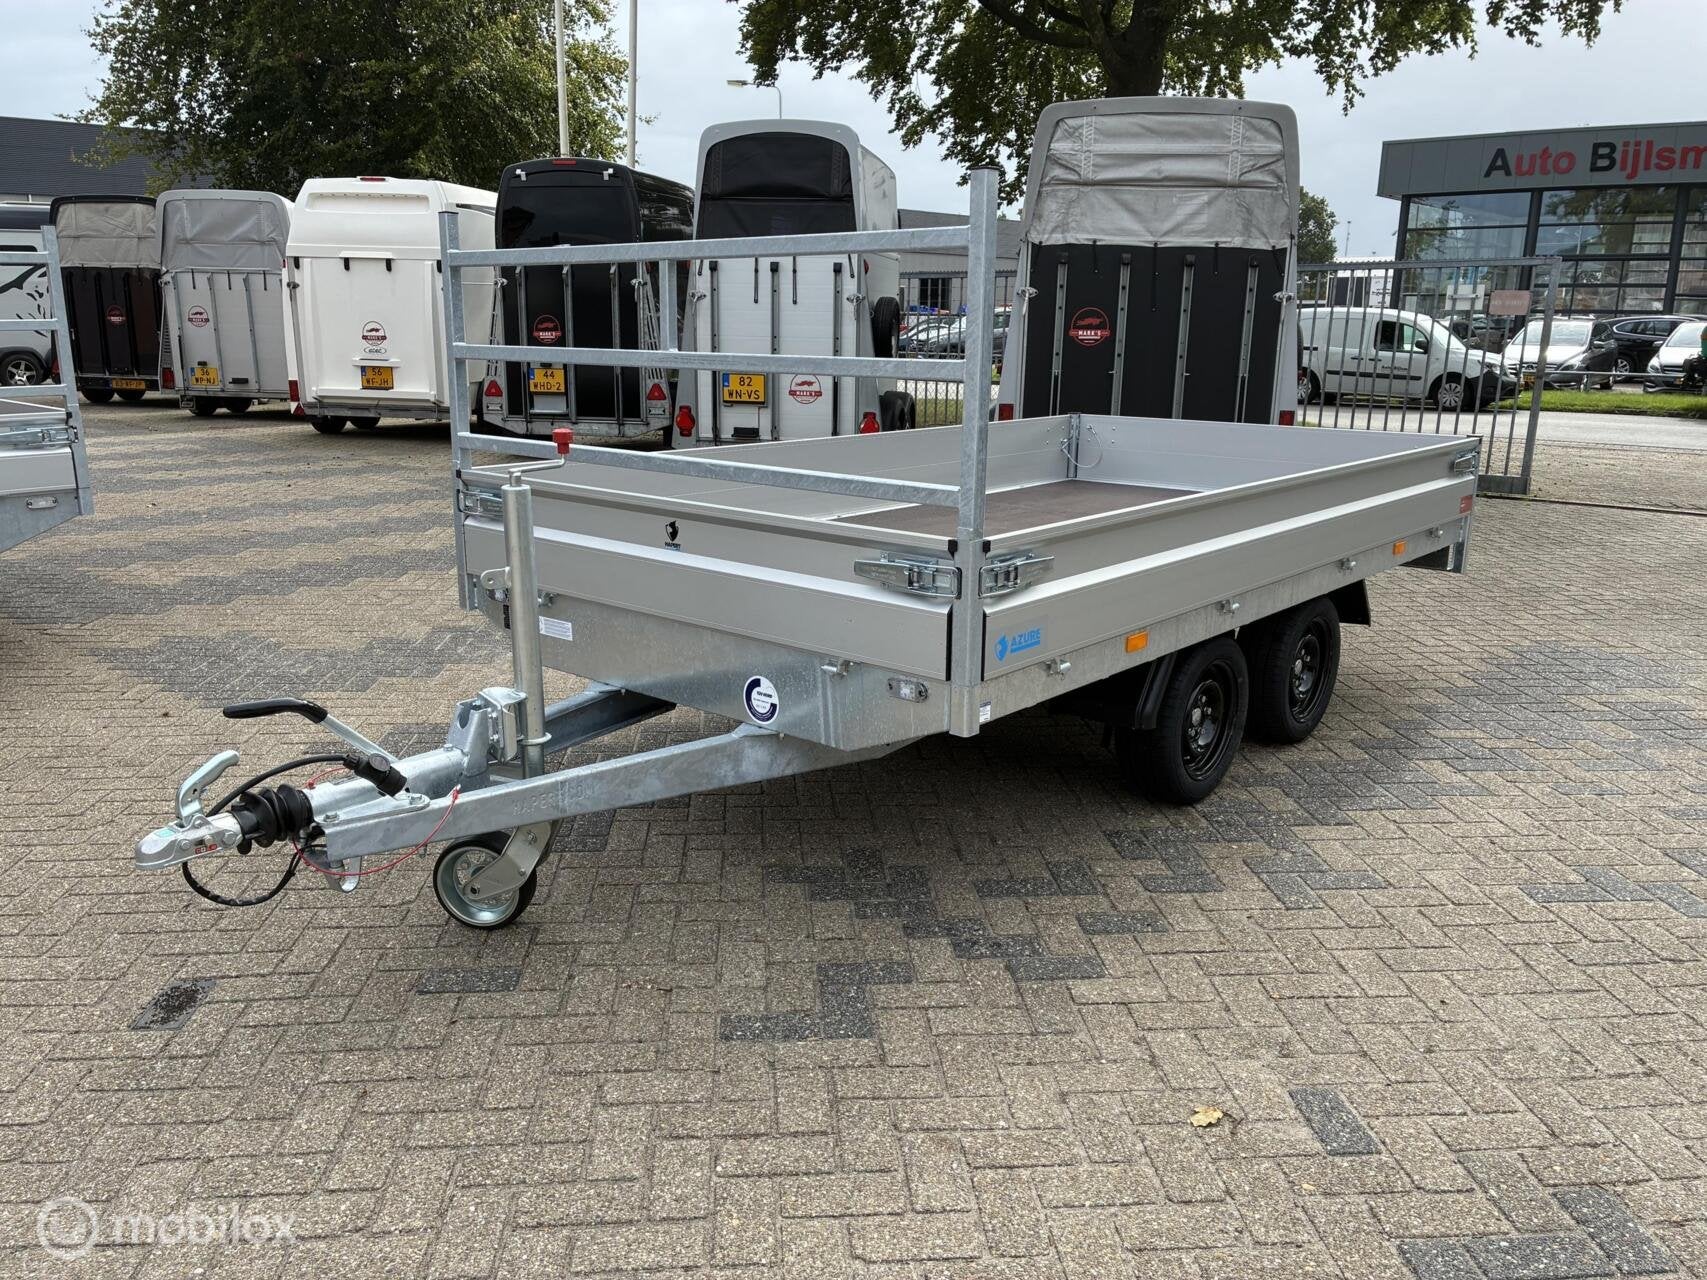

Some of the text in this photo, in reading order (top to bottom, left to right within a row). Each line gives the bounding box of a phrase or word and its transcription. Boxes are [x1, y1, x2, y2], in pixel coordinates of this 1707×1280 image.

[1483, 138, 1707, 181] Auto Bijlsm
[200, 368, 210, 377] 36
[371, 367, 383, 376] 56
[543, 370, 556, 379] 44
[365, 378, 389, 386] WF-JH
[532, 381, 562, 391] WHD-2
[738, 376, 753, 387] 82
[727, 389, 761, 400] WN-VS
[1010, 628, 1041, 647] AZURE
